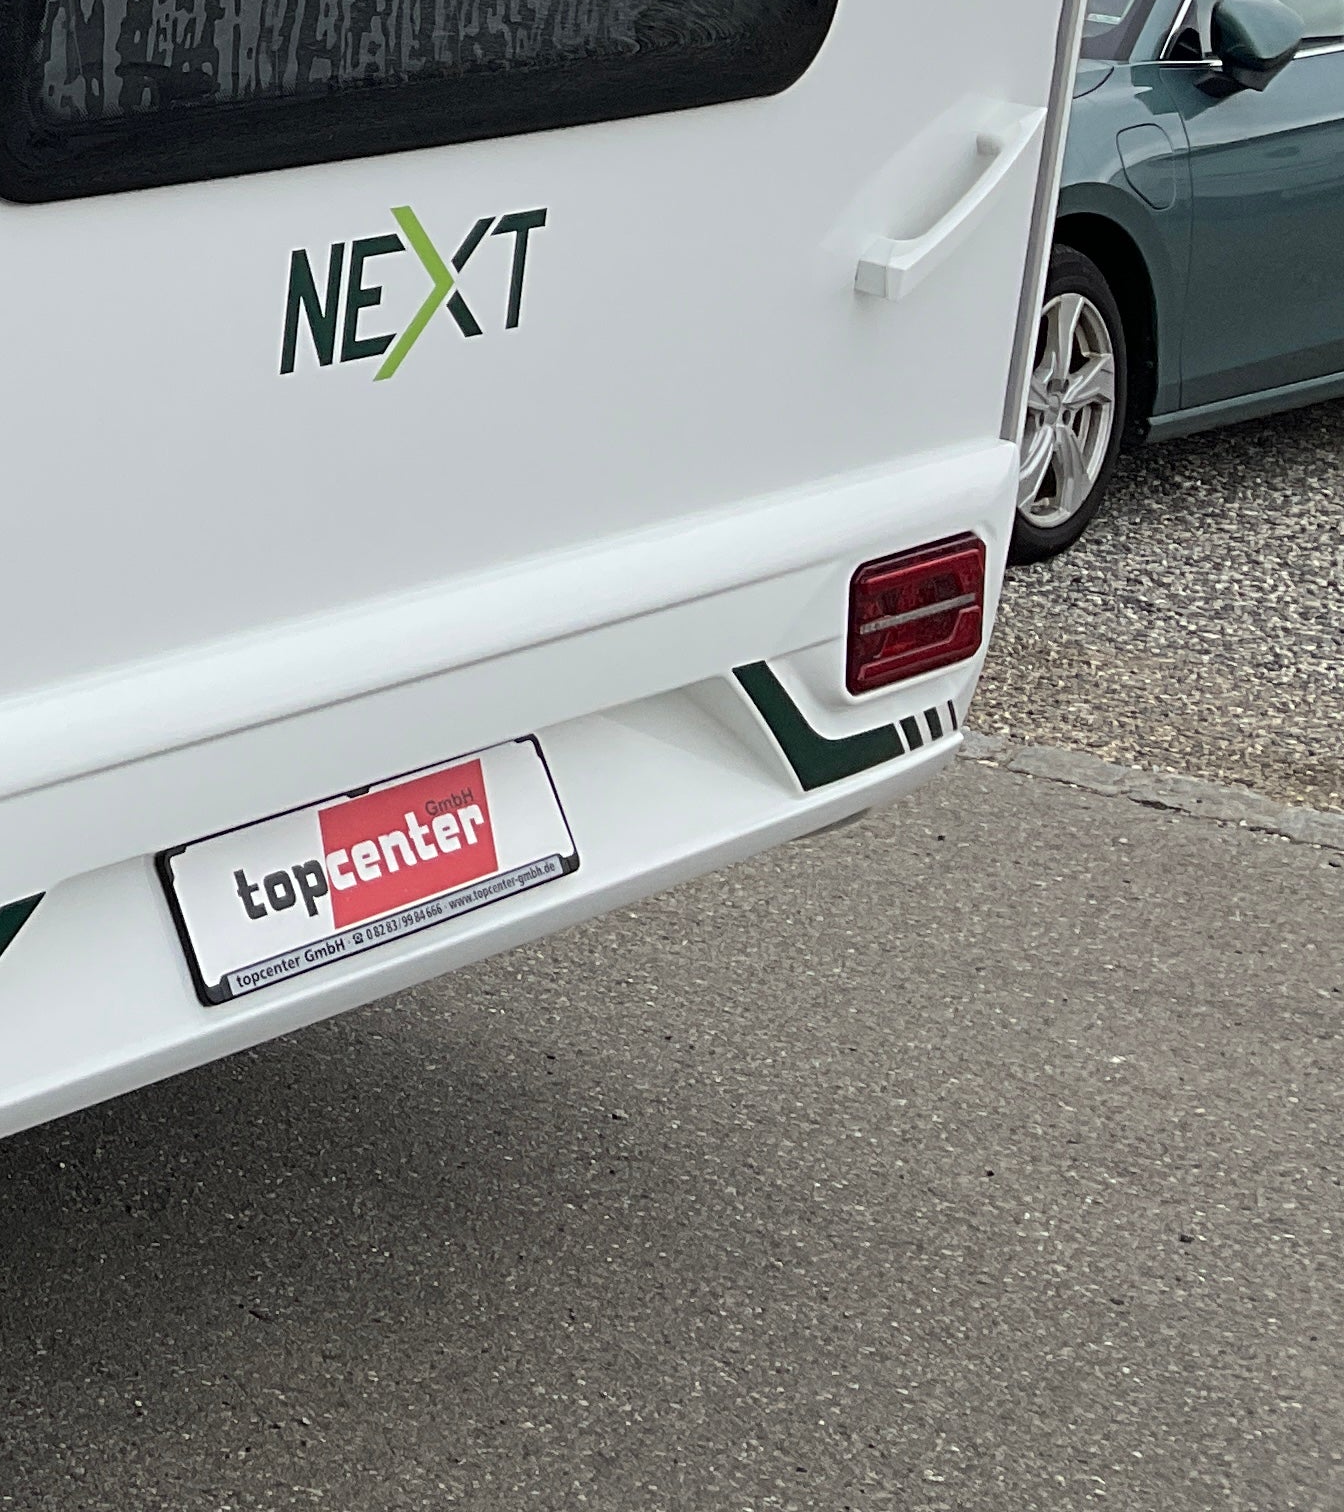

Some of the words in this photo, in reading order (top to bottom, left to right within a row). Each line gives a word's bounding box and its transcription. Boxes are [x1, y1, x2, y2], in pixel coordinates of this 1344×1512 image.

[279, 204, 548, 382] NEXT
[234, 804, 484, 920] topcenter
[425, 787, 475, 816] GmbH
[236, 956, 301, 988] topcenter
[304, 938, 346, 963] GmbH
[448, 861, 555, 910] www.topcenter-gmbh.de
